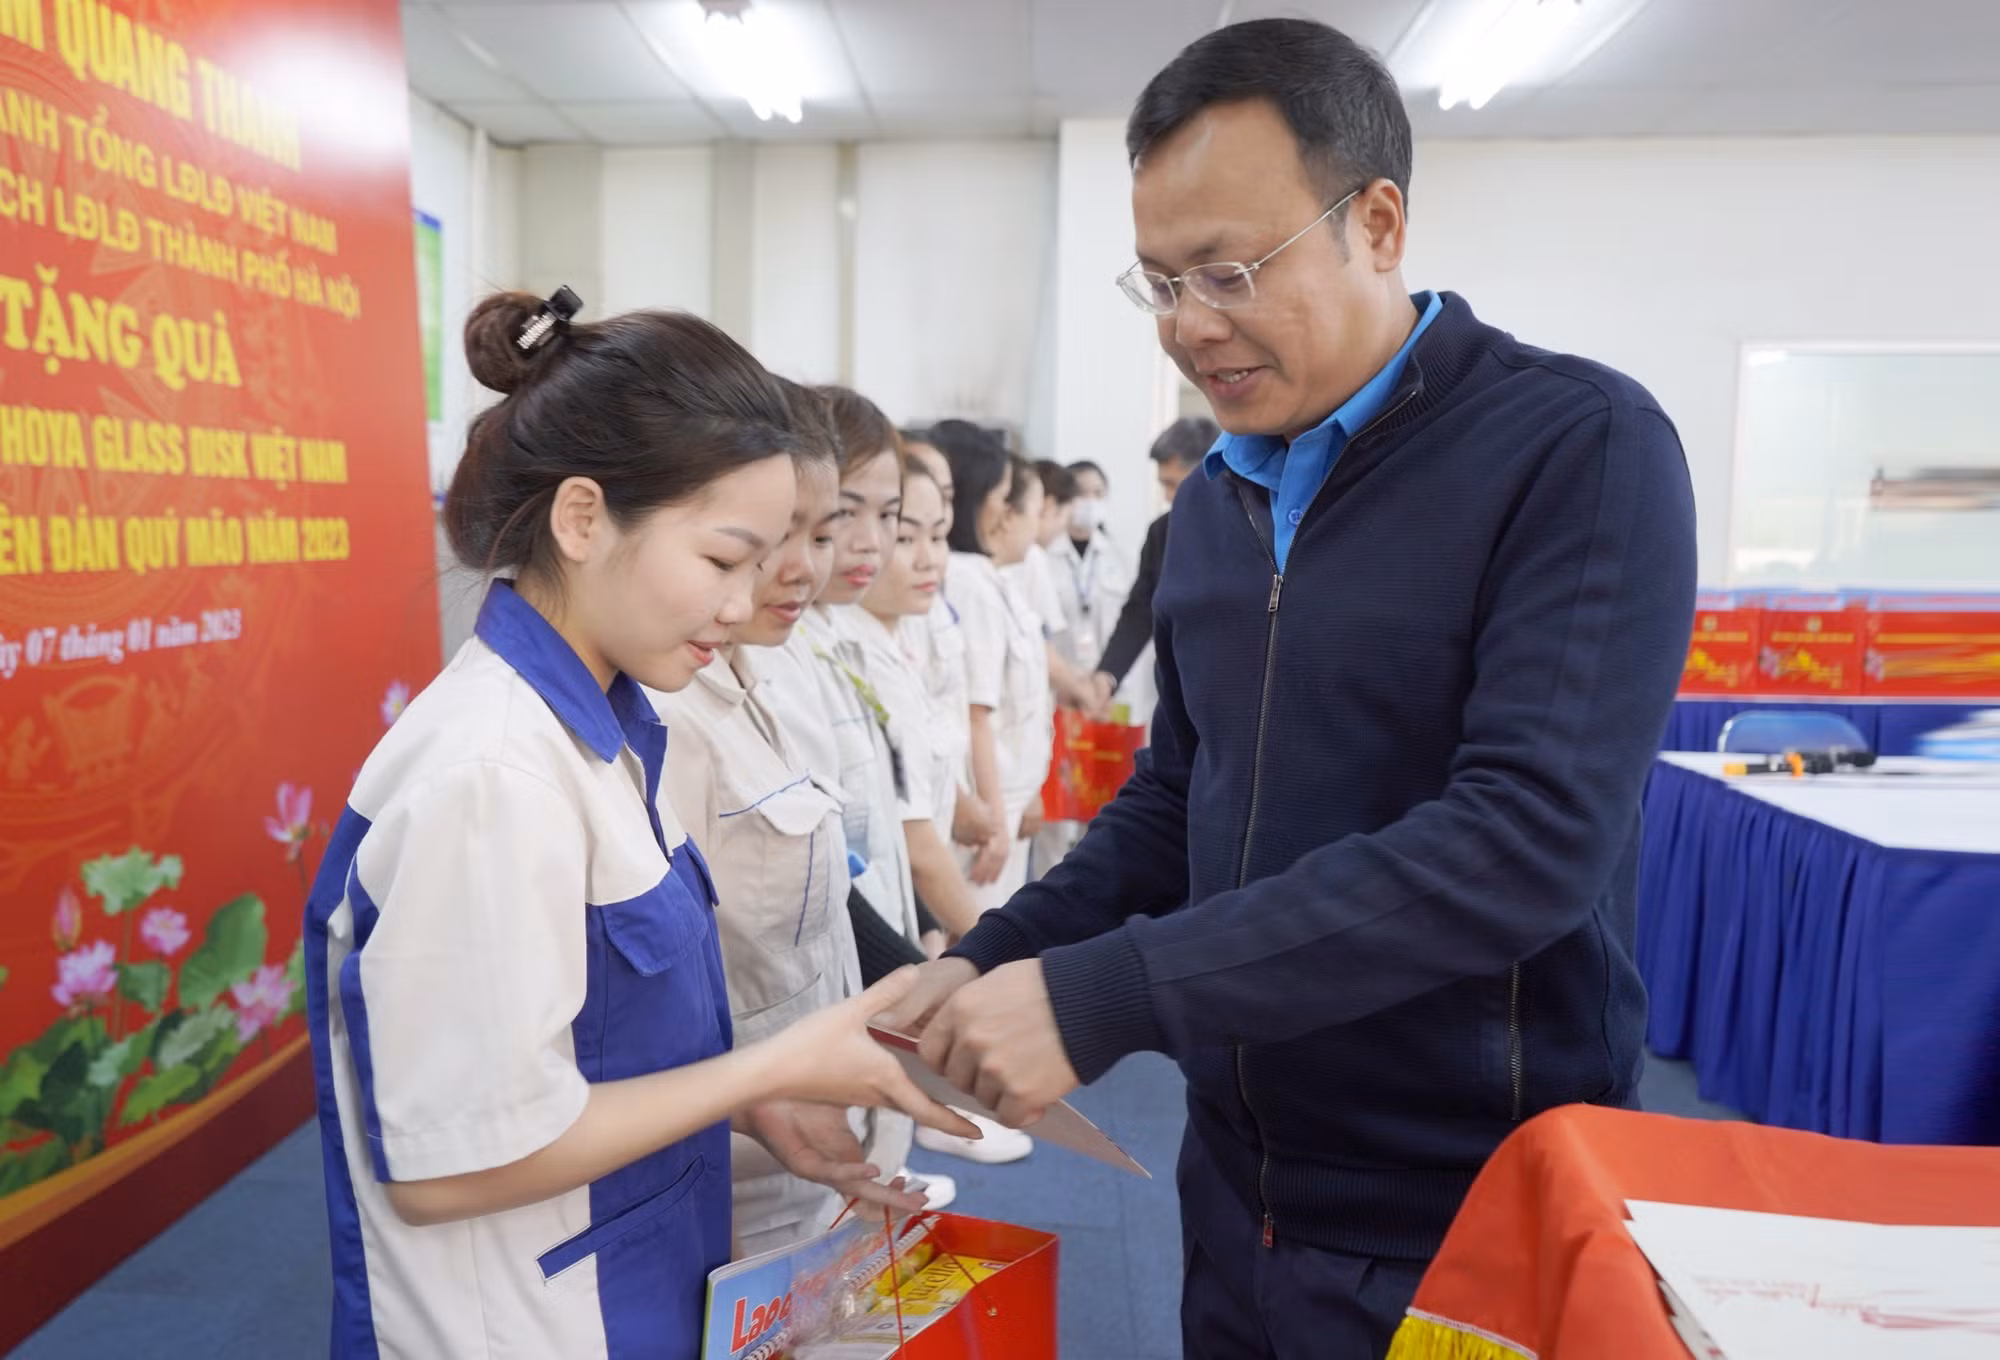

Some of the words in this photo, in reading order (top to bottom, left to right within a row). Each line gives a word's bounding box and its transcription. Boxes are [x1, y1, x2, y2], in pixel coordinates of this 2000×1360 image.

[54, 0, 193, 121] QUANG
[53, 186, 141, 253] LĐLĐ
[66, 103, 158, 188] TỔNG
[162, 154, 234, 216] LĐLĐ
[290, 206, 338, 257] NAM
[0, 262, 143, 374] TẶNG
[151, 308, 242, 391] QUÀ
[0, 404, 88, 470] HOYA
[92, 413, 187, 477] GLASS
[189, 425, 250, 480] DISK
[251, 424, 297, 491] VIỆT
[300, 437, 349, 484] NAM
[301, 516, 351, 562] 2023
[25, 627, 57, 667] 07
[127, 617, 152, 653] 01
[200, 607, 242, 643] 2023
